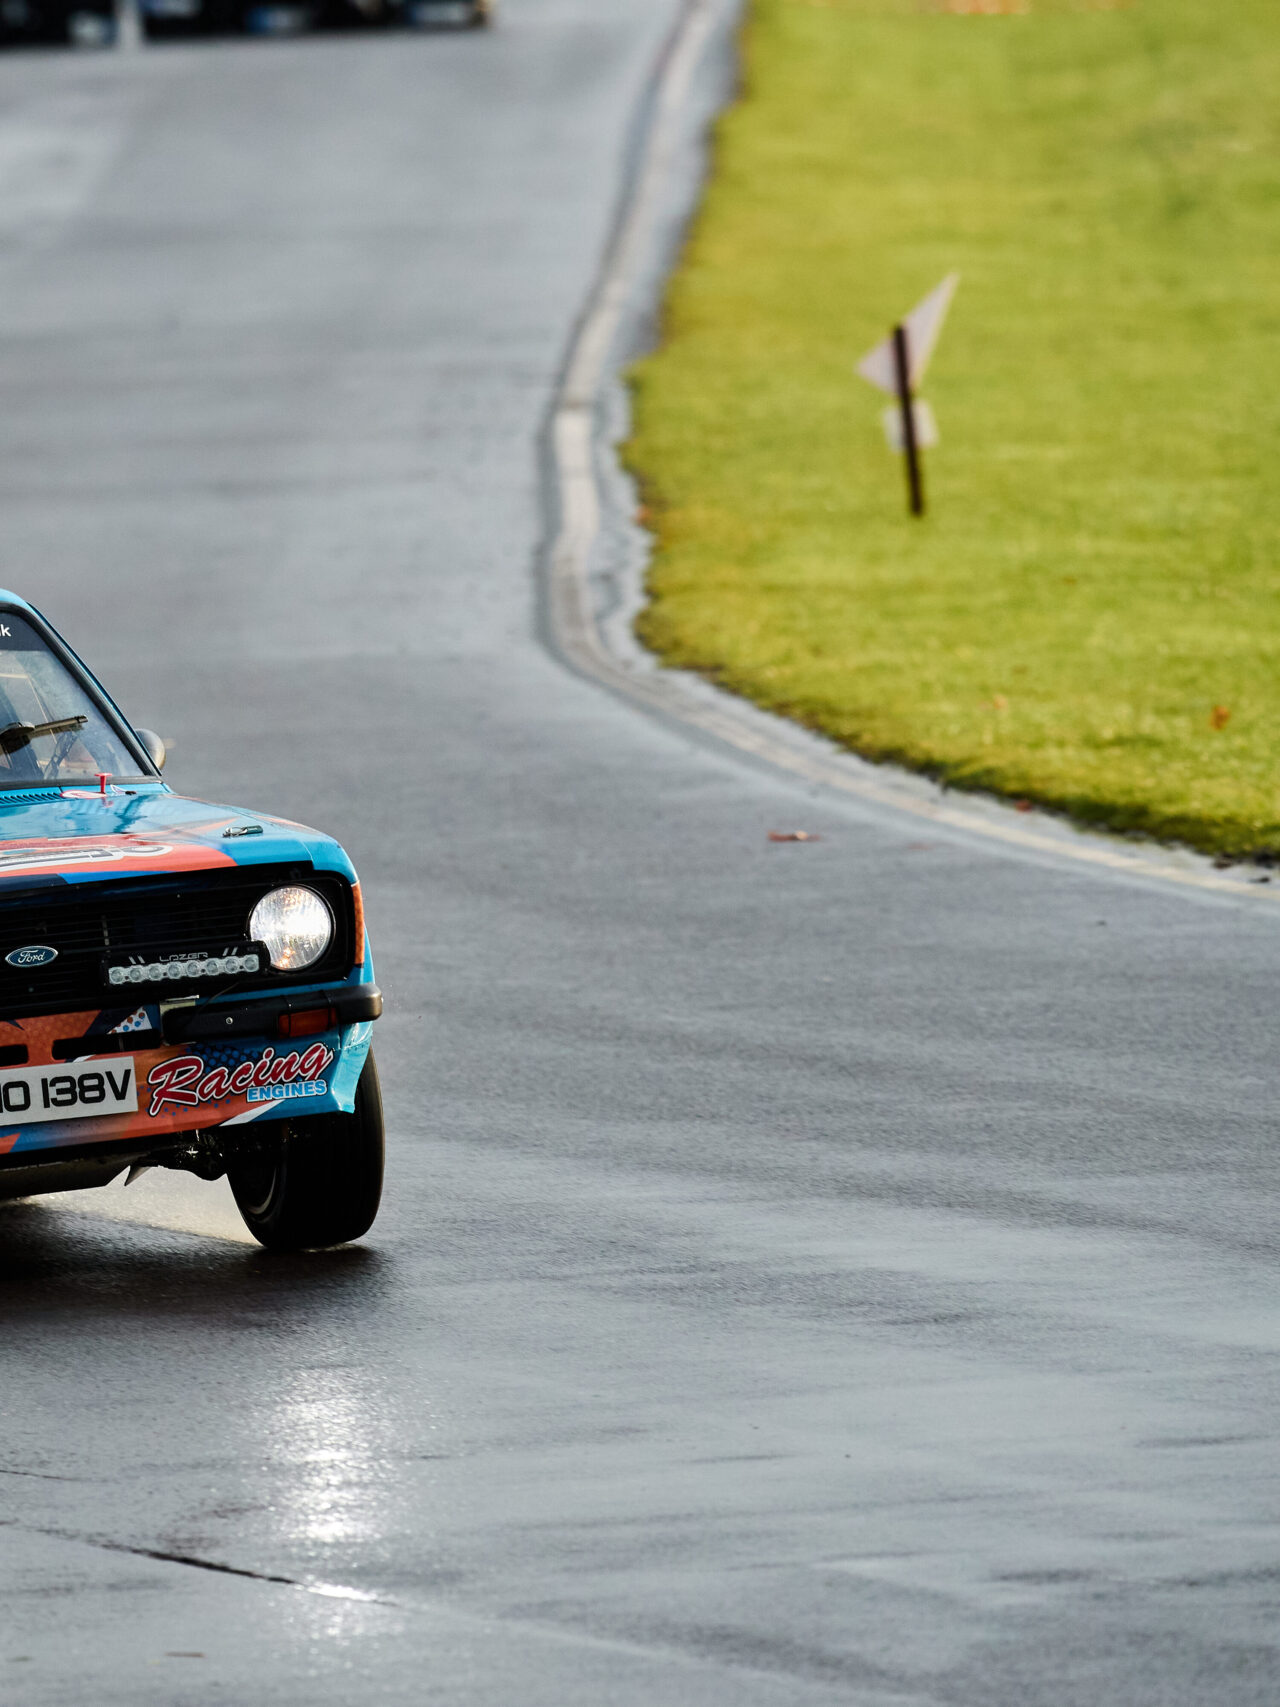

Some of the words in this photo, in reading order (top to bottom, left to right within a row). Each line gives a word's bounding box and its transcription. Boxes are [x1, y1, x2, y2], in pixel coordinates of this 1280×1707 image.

[159, 951, 209, 962] LAZER
[42, 1068, 132, 1109] 138V
[148, 1043, 334, 1117] Racing
[247, 1080, 328, 1103] ENGINES
